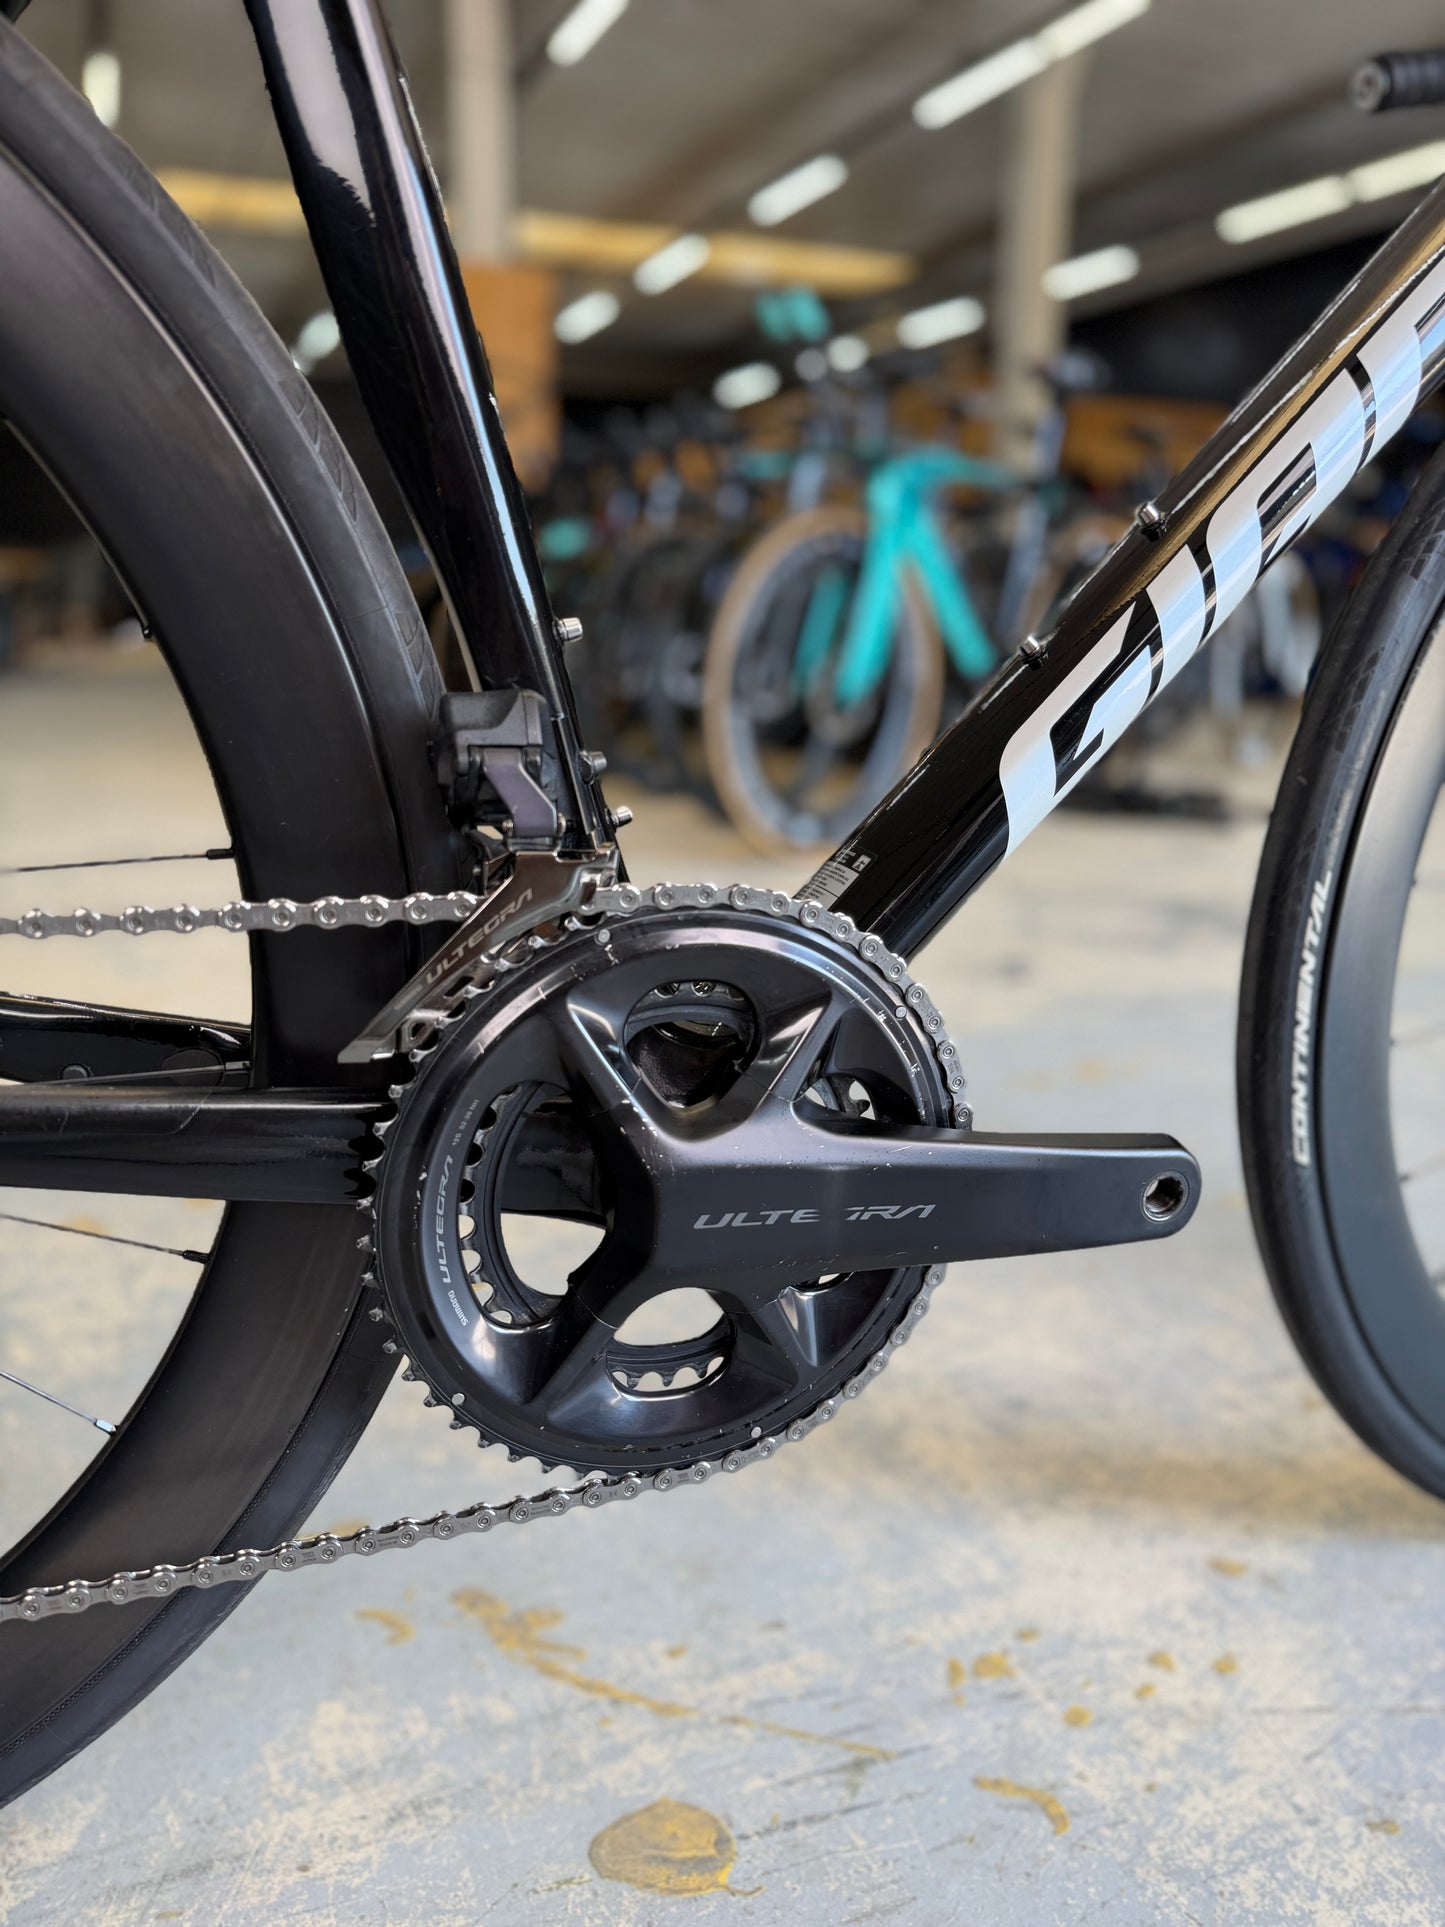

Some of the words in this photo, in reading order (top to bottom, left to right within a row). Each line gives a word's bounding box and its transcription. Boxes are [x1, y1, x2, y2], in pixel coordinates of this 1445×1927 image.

[425, 888, 533, 984] ULTEGRA
[1291, 870, 1332, 1166] CONTINENTAL
[435, 1155, 453, 1283] ULTEGRA
[447, 1289, 469, 1327] SHIMANO
